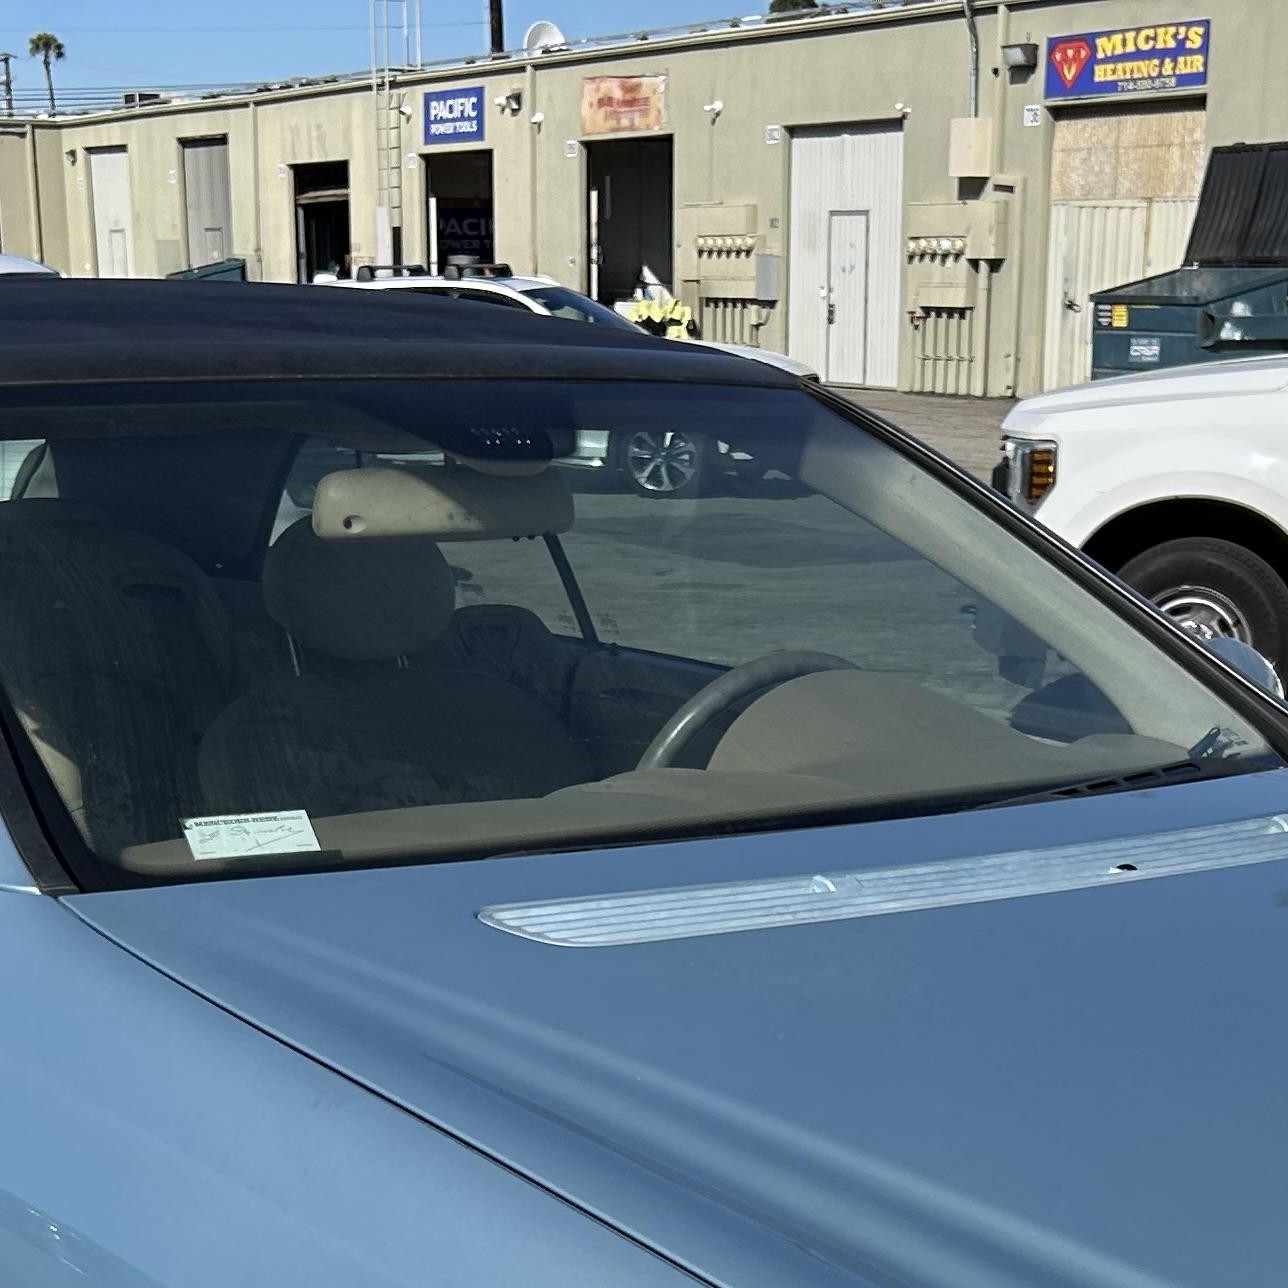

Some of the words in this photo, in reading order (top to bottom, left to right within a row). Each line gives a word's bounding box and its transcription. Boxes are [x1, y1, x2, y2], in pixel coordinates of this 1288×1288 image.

[1095, 26, 1205, 59] MICK'S
[1094, 59, 1160, 83] HEATING
[1162, 58, 1174, 76] &
[1175, 55, 1204, 75] AIR
[429, 97, 478, 121] PACIFIC
